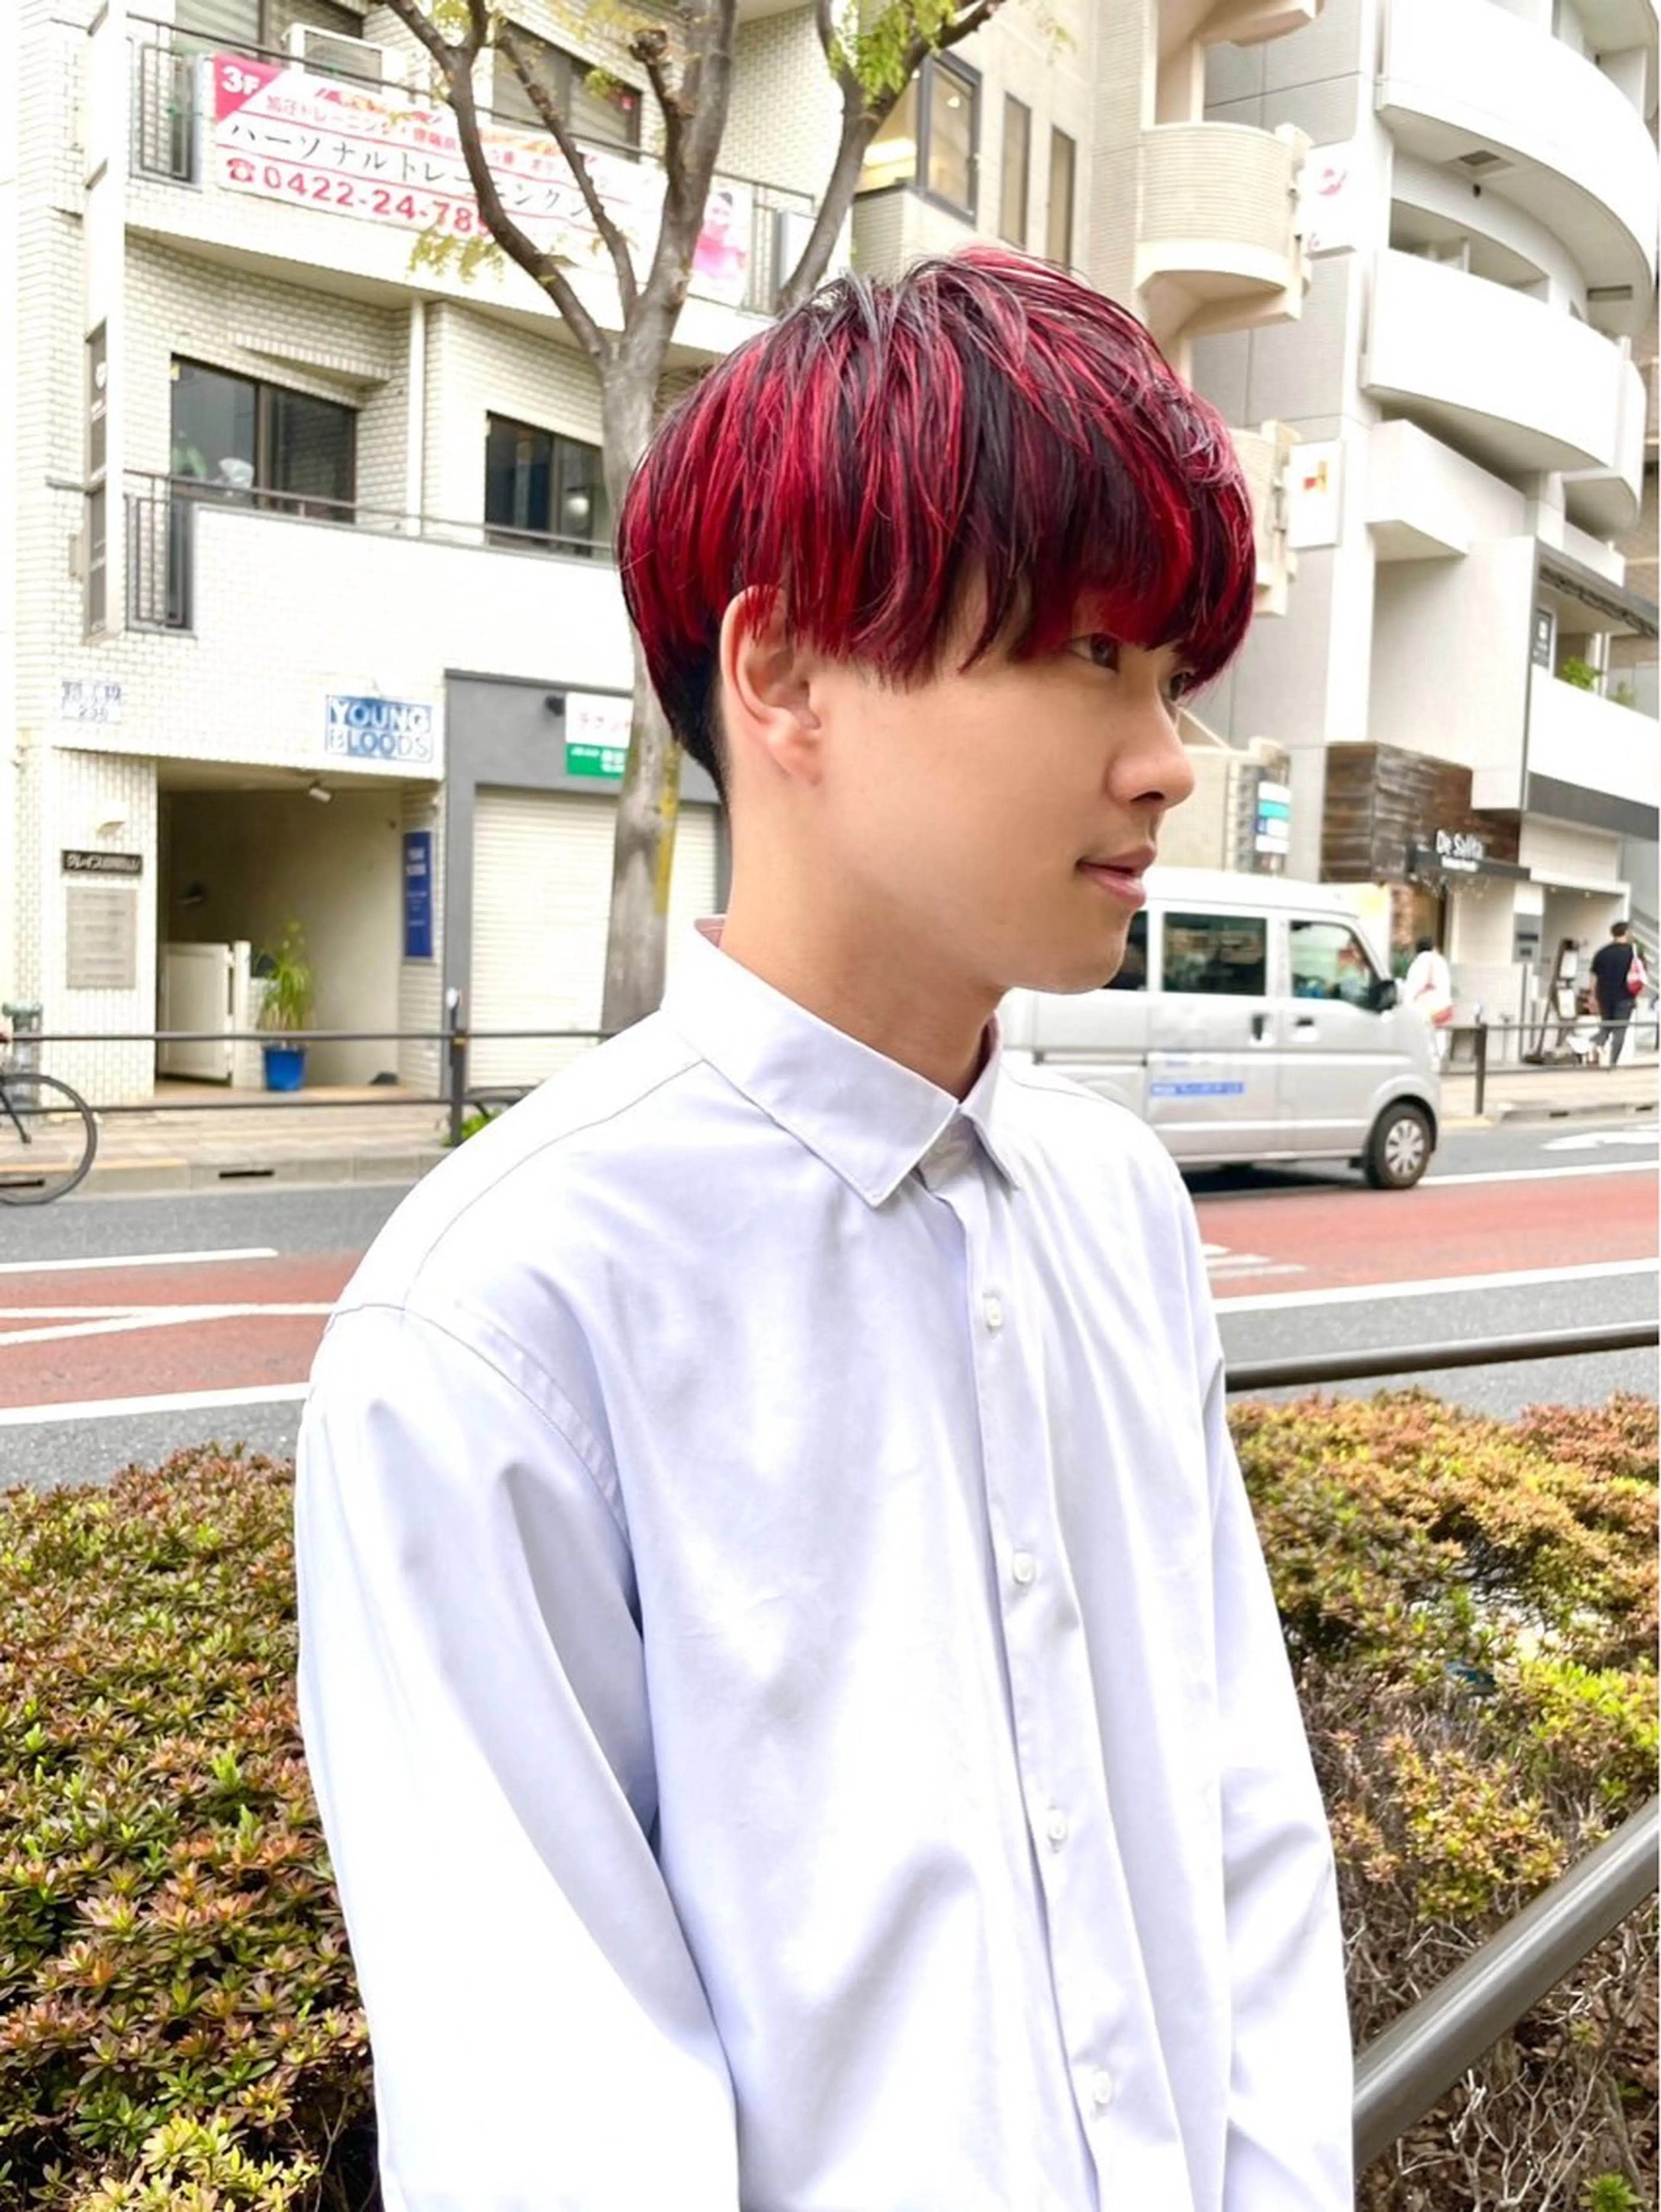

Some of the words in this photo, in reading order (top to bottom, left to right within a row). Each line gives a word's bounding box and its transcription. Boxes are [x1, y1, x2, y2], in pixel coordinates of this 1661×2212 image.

[222, 66, 260, 95] 3F
[330, 698, 430, 732] YOUNG
[329, 728, 429, 758] BLOODS
